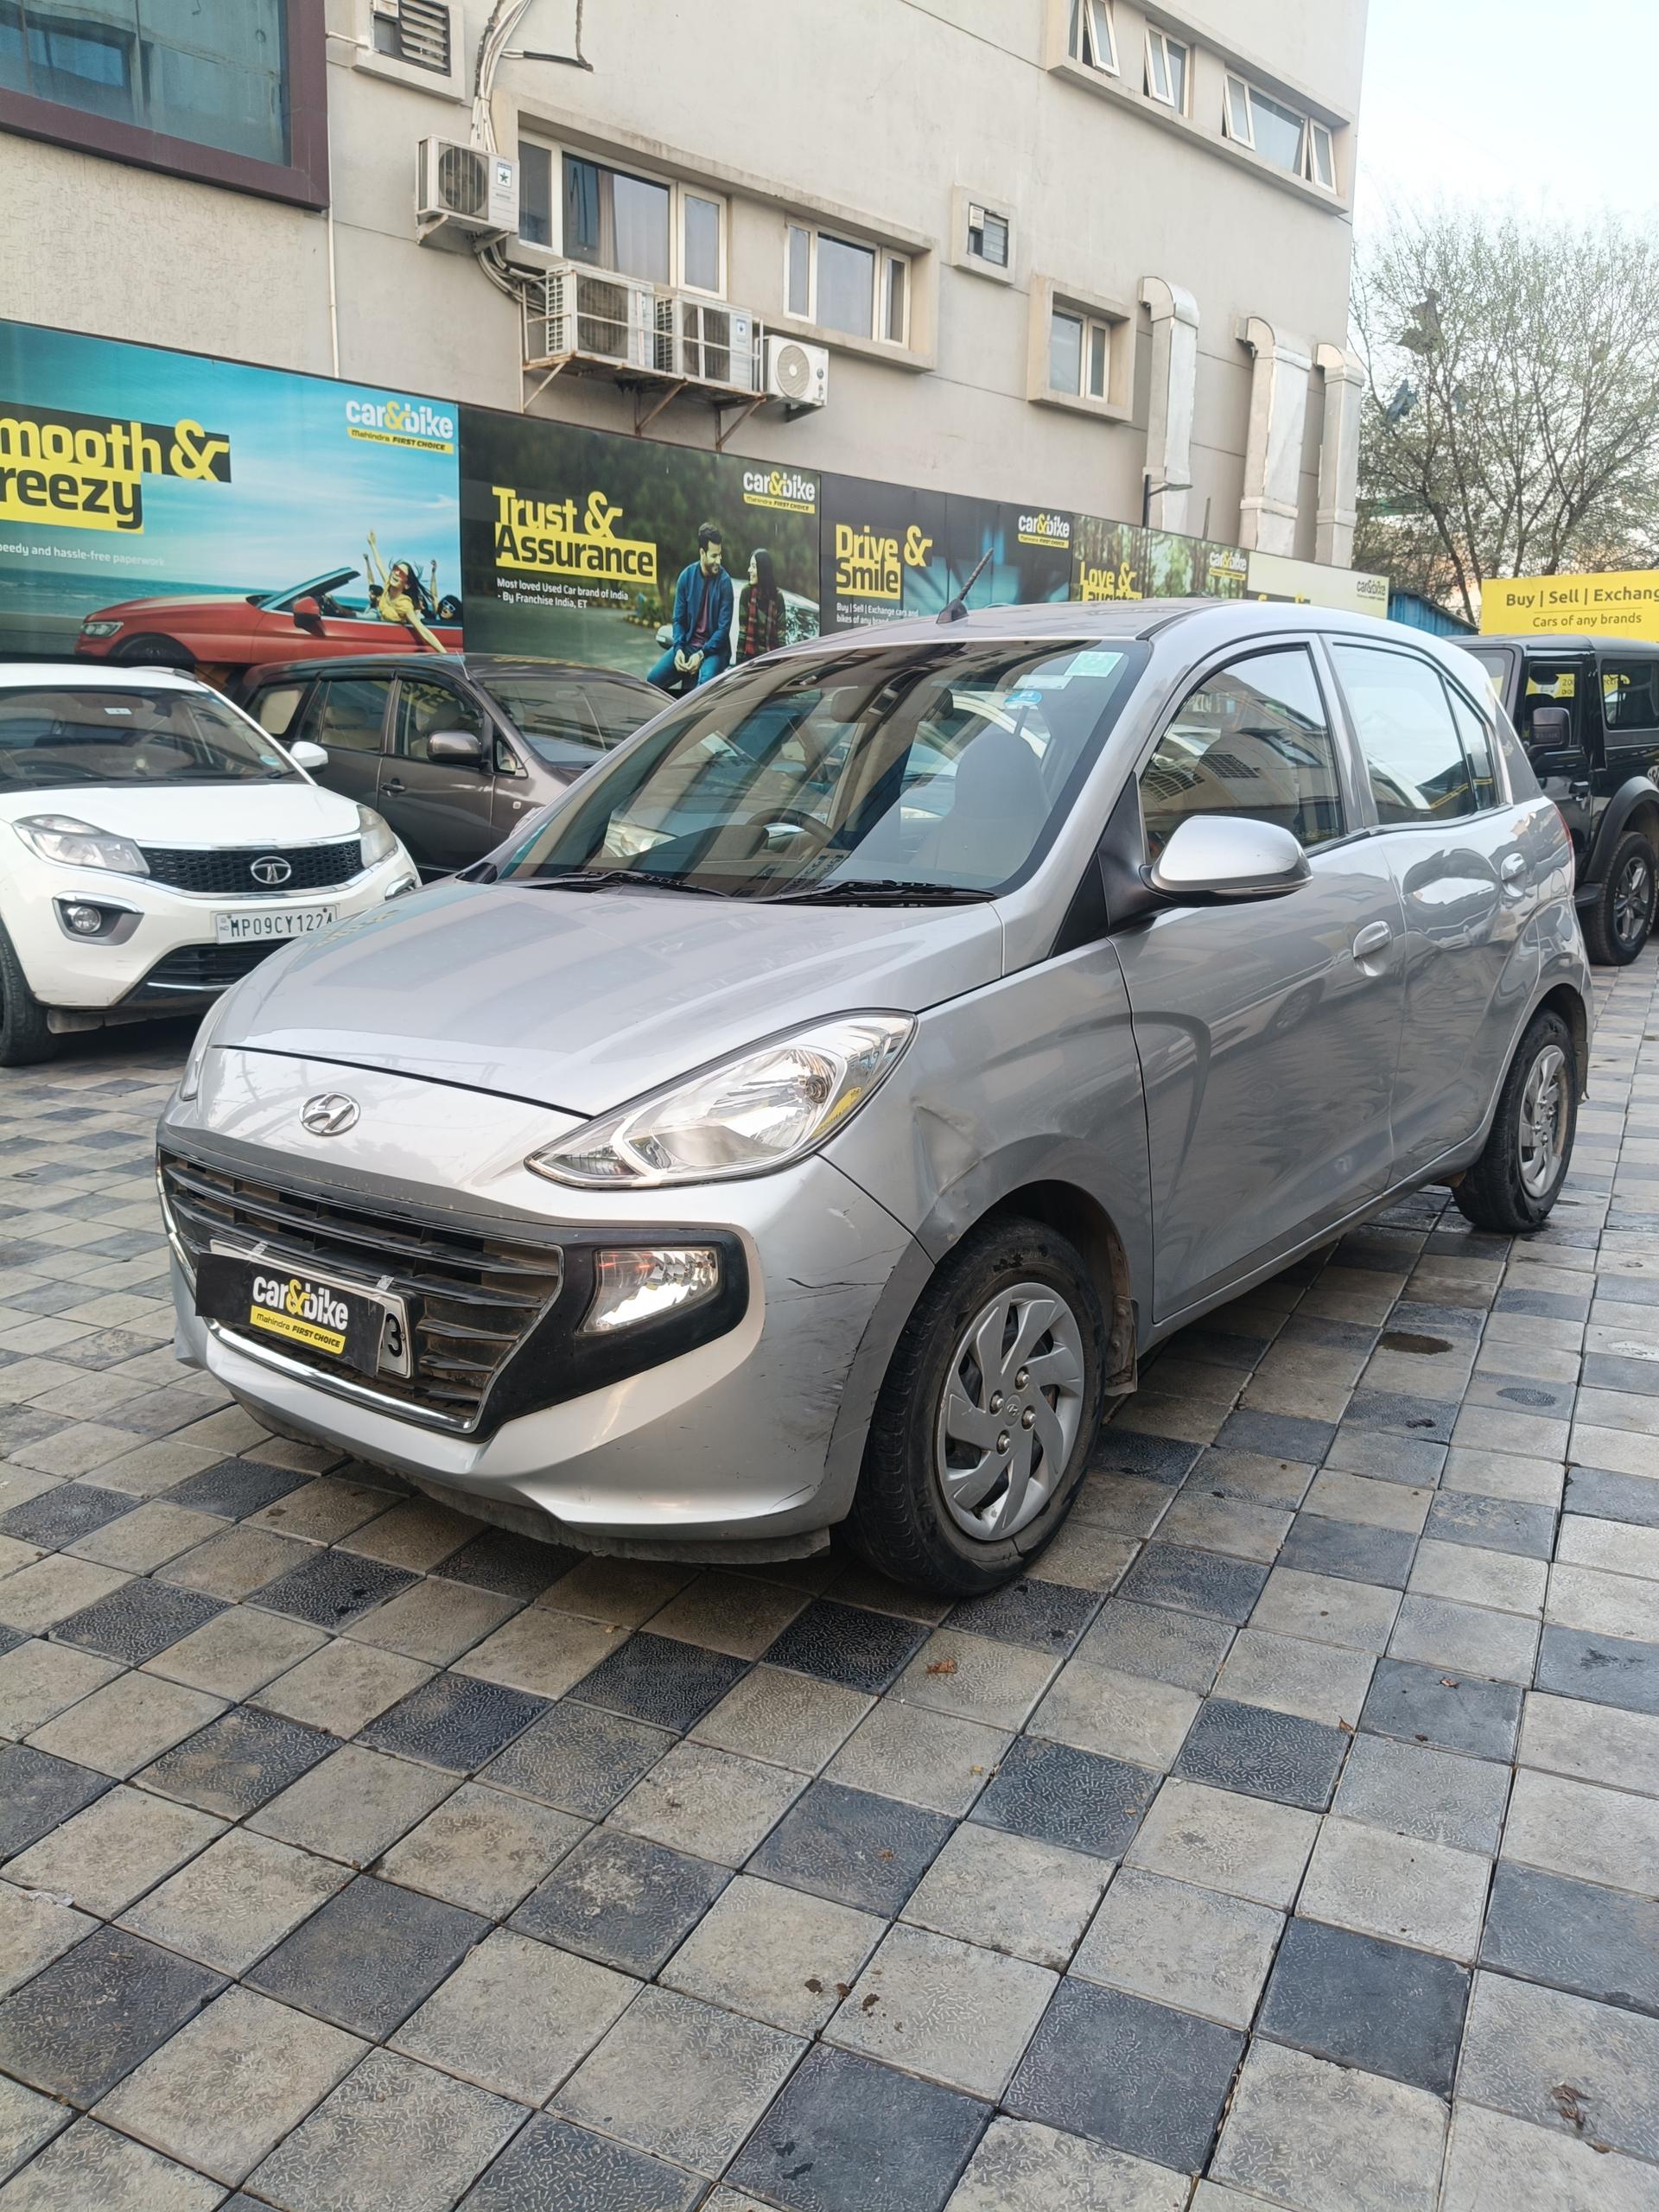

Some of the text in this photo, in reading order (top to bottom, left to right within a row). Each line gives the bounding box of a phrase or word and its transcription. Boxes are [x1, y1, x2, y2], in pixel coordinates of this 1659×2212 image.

[346, 400, 454, 439] car&bike
[169, 418, 230, 483] &
[392, 437, 416, 448] FIRST
[416, 442, 446, 451] CHOICE
[743, 471, 816, 501] car&bike
[493, 486, 623, 538] Trust &
[1018, 513, 1071, 538] car&bike
[31, 546, 51, 556] and
[54, 547, 111, 562] hassle-free
[496, 524, 654, 577] Assurance
[836, 524, 933, 567] Drive &
[497, 578, 629, 601] Most loved Used Car brand of India
[836, 557, 899, 594] Smile
[1080, 561, 1115, 590] Love
[1118, 562, 1137, 592] &
[502, 591, 514, 603] By
[516, 593, 553, 606] Franchise
[555, 597, 576, 608] India,
[577, 599, 588, 608] ET
[836, 602, 849, 613] Buy
[853, 604, 864, 613] Sell
[868, 605, 894, 617] Exchange
[1506, 594, 1535, 607] Buy
[1548, 589, 1580, 604] Sell
[853, 614, 860, 623] of
[1533, 613, 1642, 627] Cars of any brands
[252, 1276, 349, 1331] car&bike
[257, 1313, 340, 1348] Mahindra FIRST CHOICE
